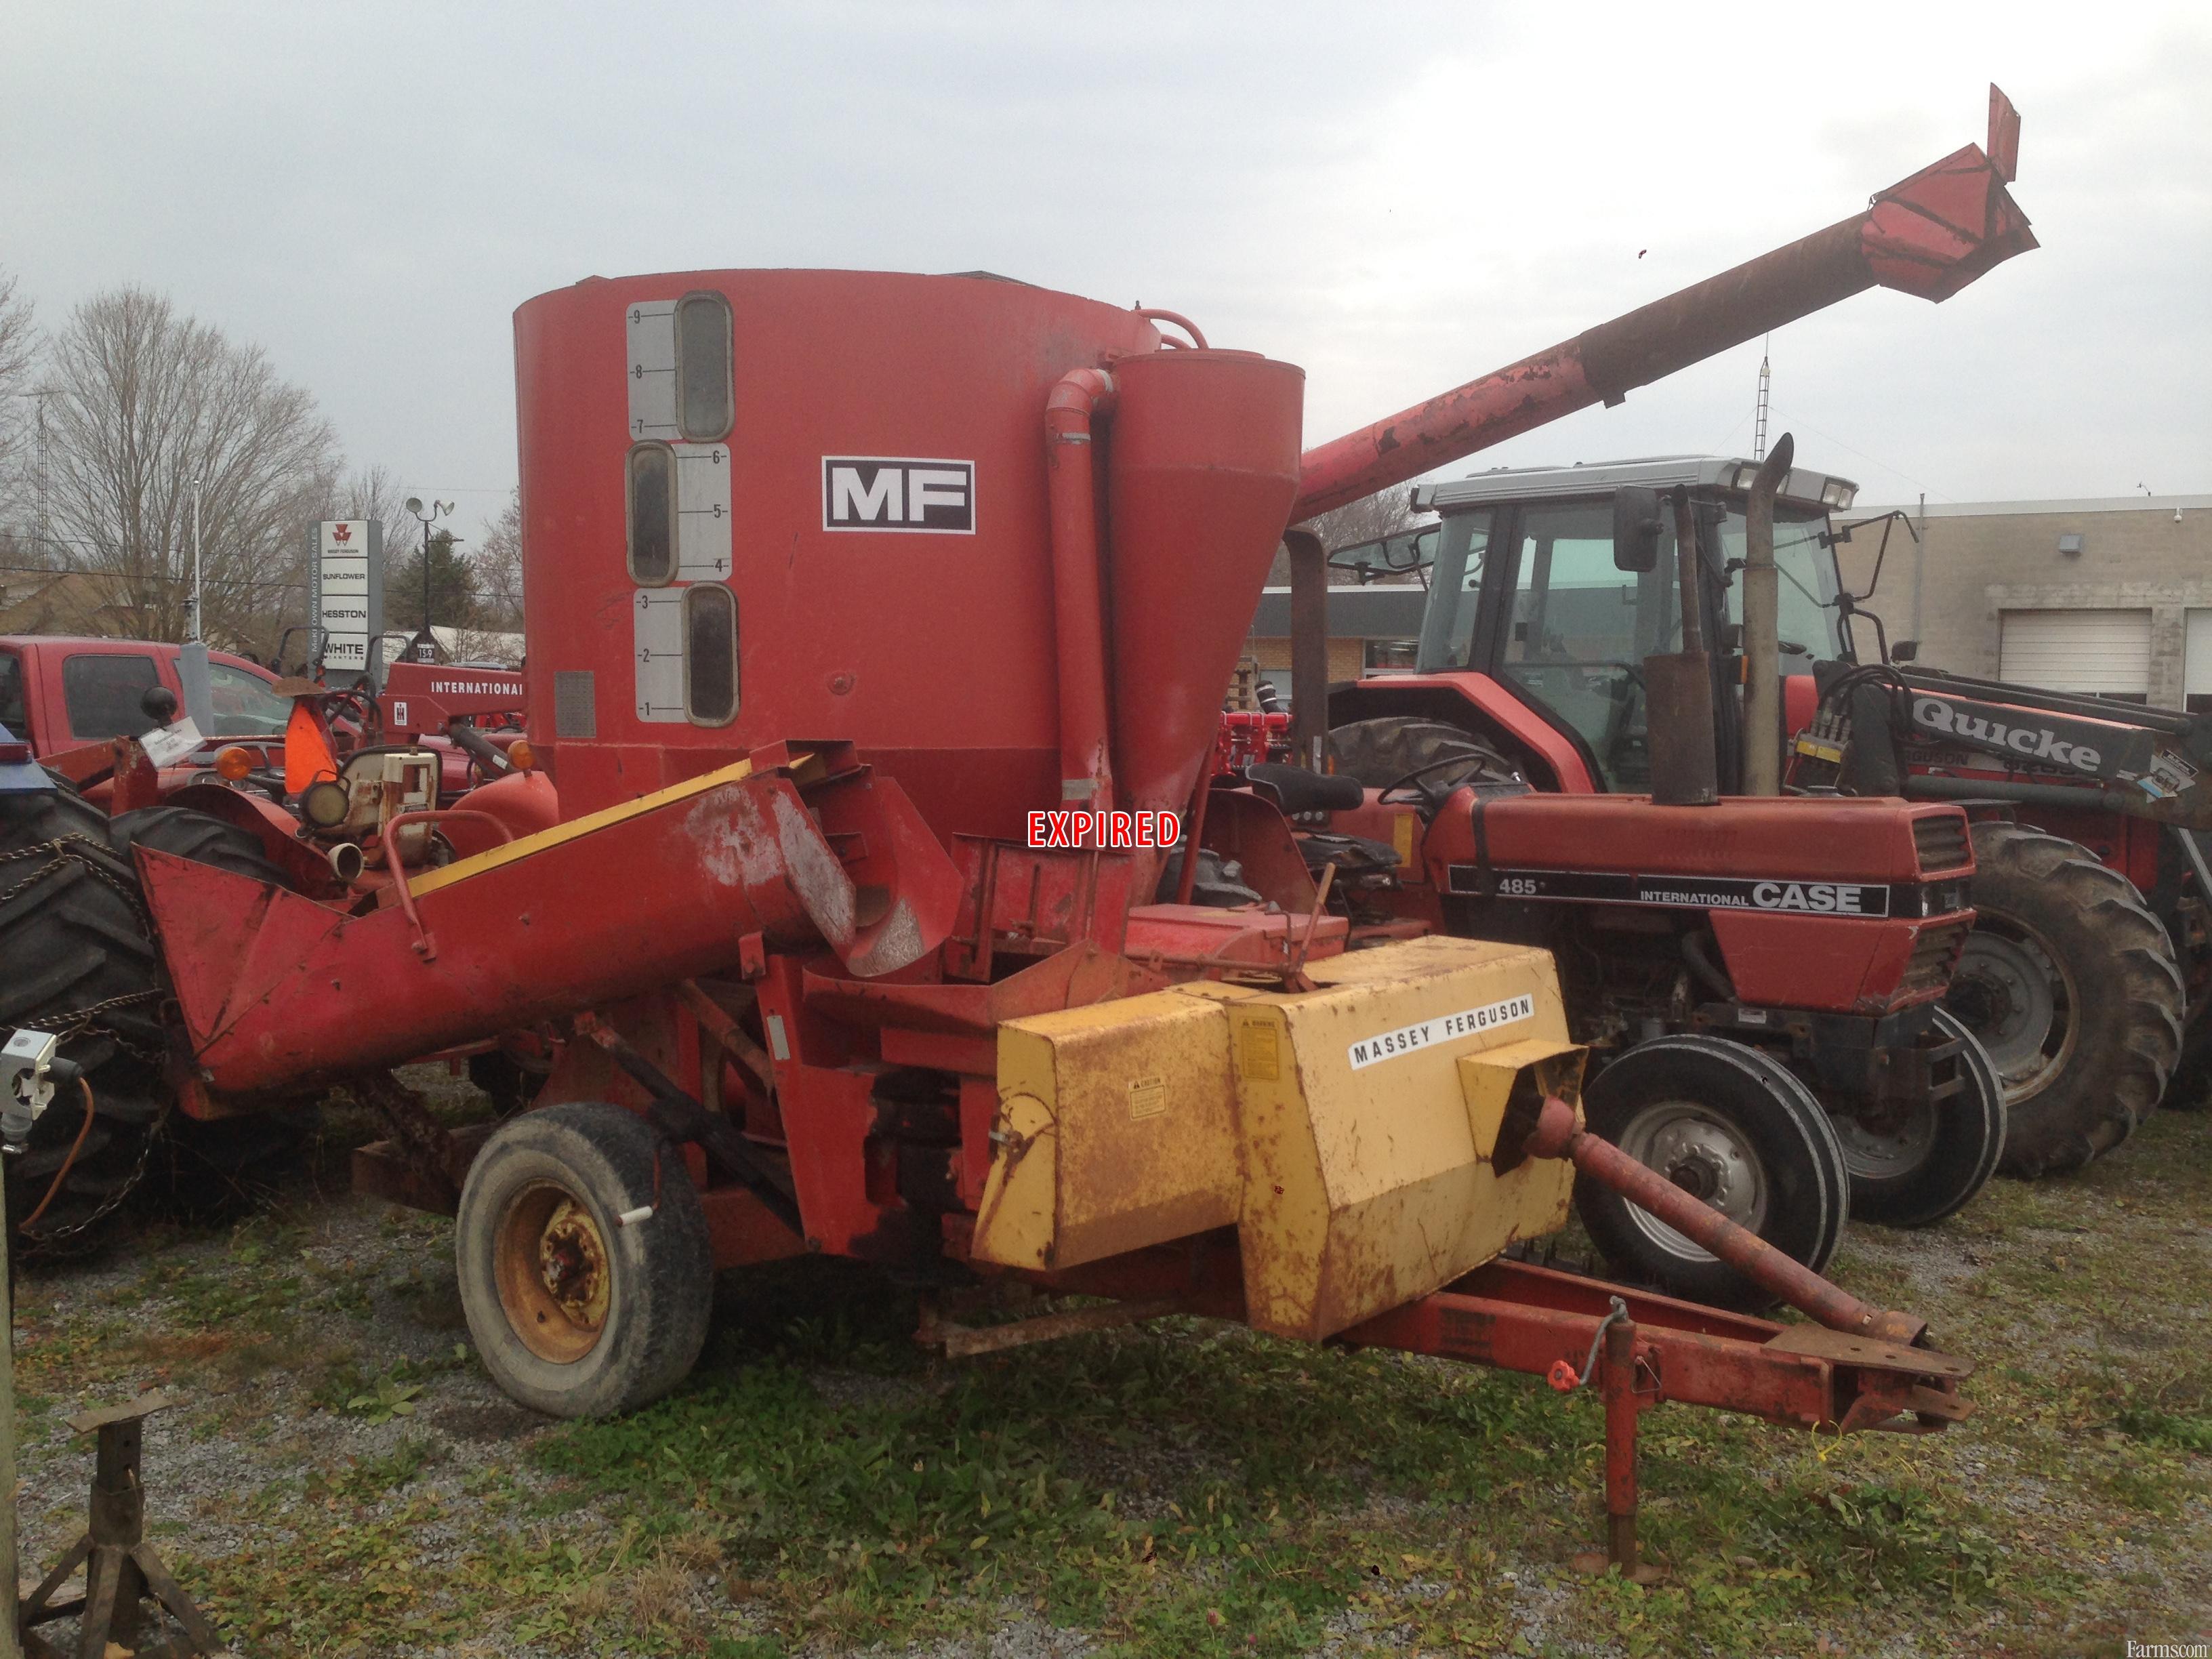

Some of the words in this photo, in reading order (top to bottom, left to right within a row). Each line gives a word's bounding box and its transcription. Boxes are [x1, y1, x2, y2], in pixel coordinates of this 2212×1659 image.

[634, 310, 640, 324] 9
[636, 365, 642, 379] 8
[636, 419, 643, 433] 7
[713, 450, 720, 464] 6
[832, 467, 966, 521] MF
[714, 504, 721, 518] 5
[714, 559, 722, 573] 4
[642, 595, 649, 609] 3
[322, 610, 367, 618] HESSTON
[325, 643, 364, 655] WHITE
[643, 649, 650, 662] 2
[644, 702, 650, 716] 1
[1912, 698, 2101, 771] Quicke
[1499, 879, 1536, 894] 485
[1640, 890, 1749, 907] INTERNATIONAL
[1753, 882, 1862, 912] CASE
[1354, 1026, 1429, 1063] MASSEY
[1445, 1000, 1529, 1036] FERGUSON
